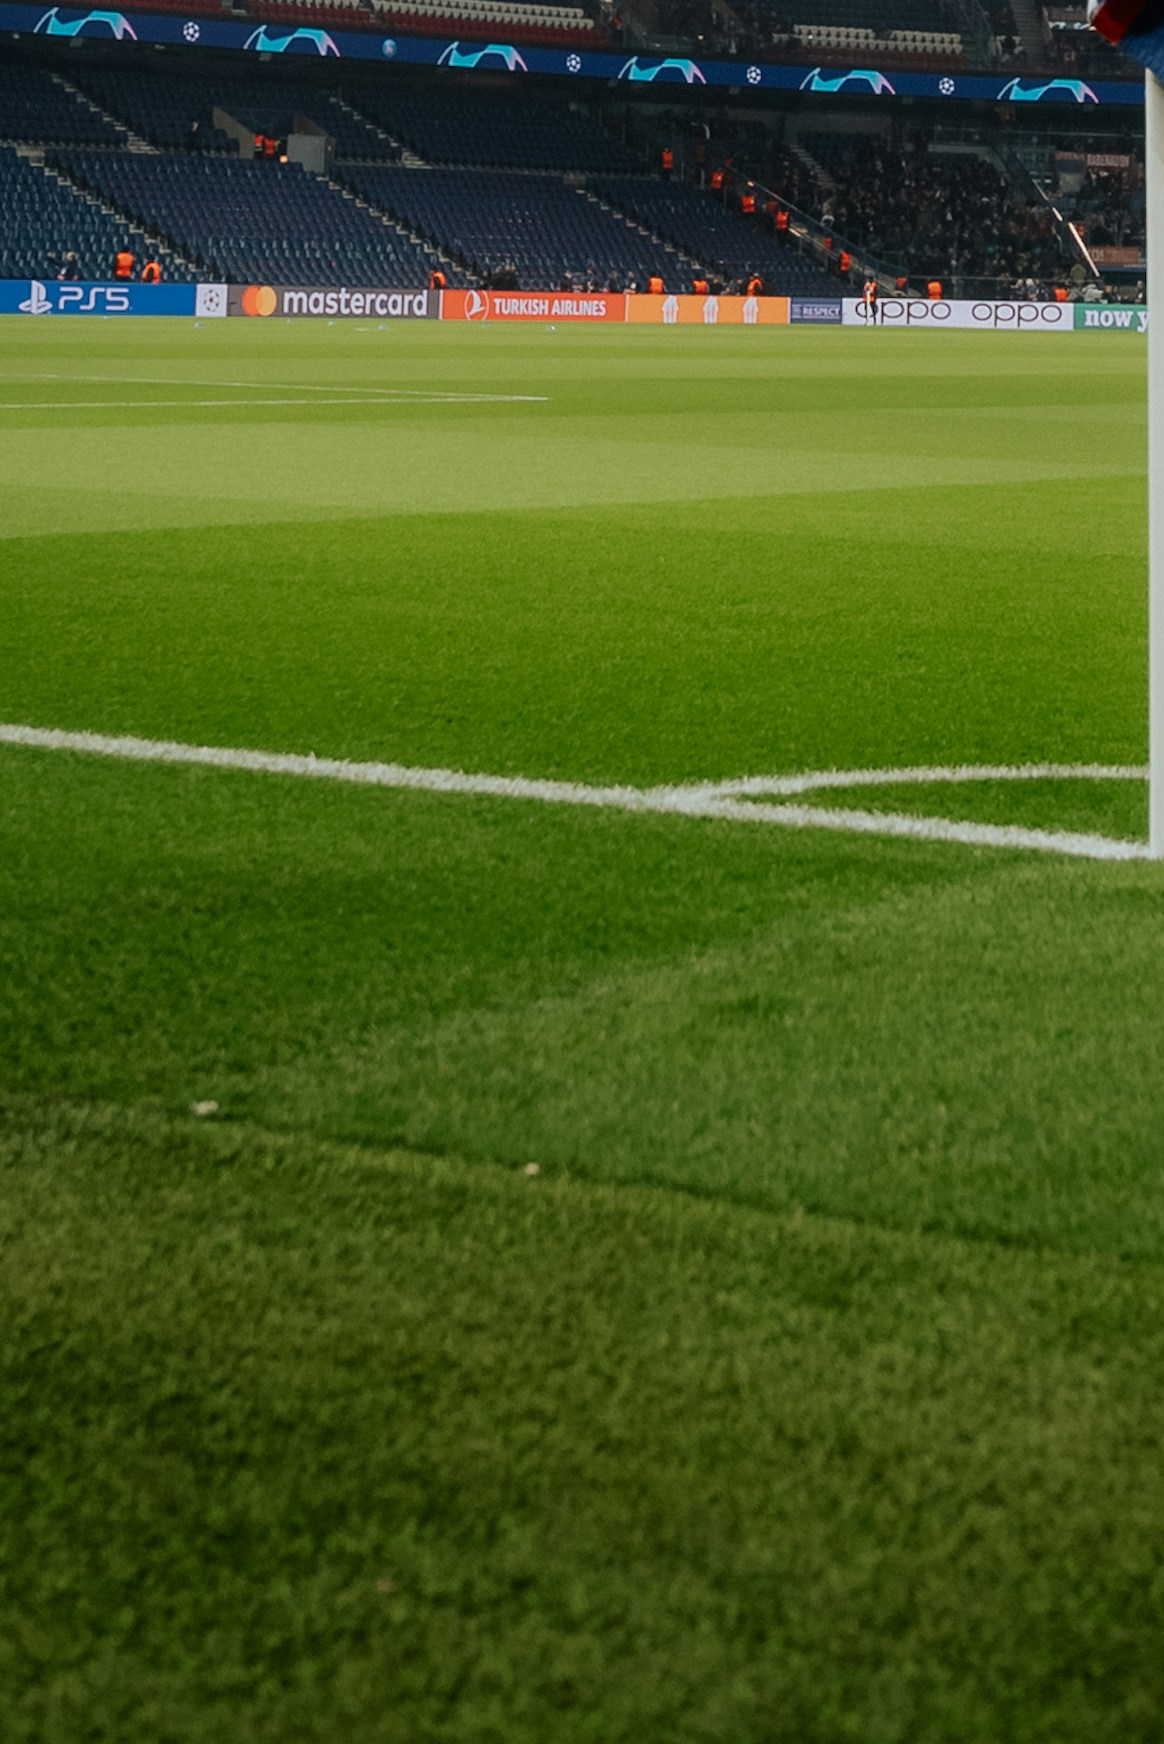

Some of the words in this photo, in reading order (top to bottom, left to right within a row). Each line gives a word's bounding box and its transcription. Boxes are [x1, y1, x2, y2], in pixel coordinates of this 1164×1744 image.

[60, 287, 130, 311] PS5
[283, 288, 428, 317] mastercard
[493, 297, 549, 316] TURKISH
[550, 299, 607, 317] AIRLINES
[802, 306, 840, 316] RESPECT
[972, 302, 1063, 328] oppo
[1084, 309, 1133, 327] now
